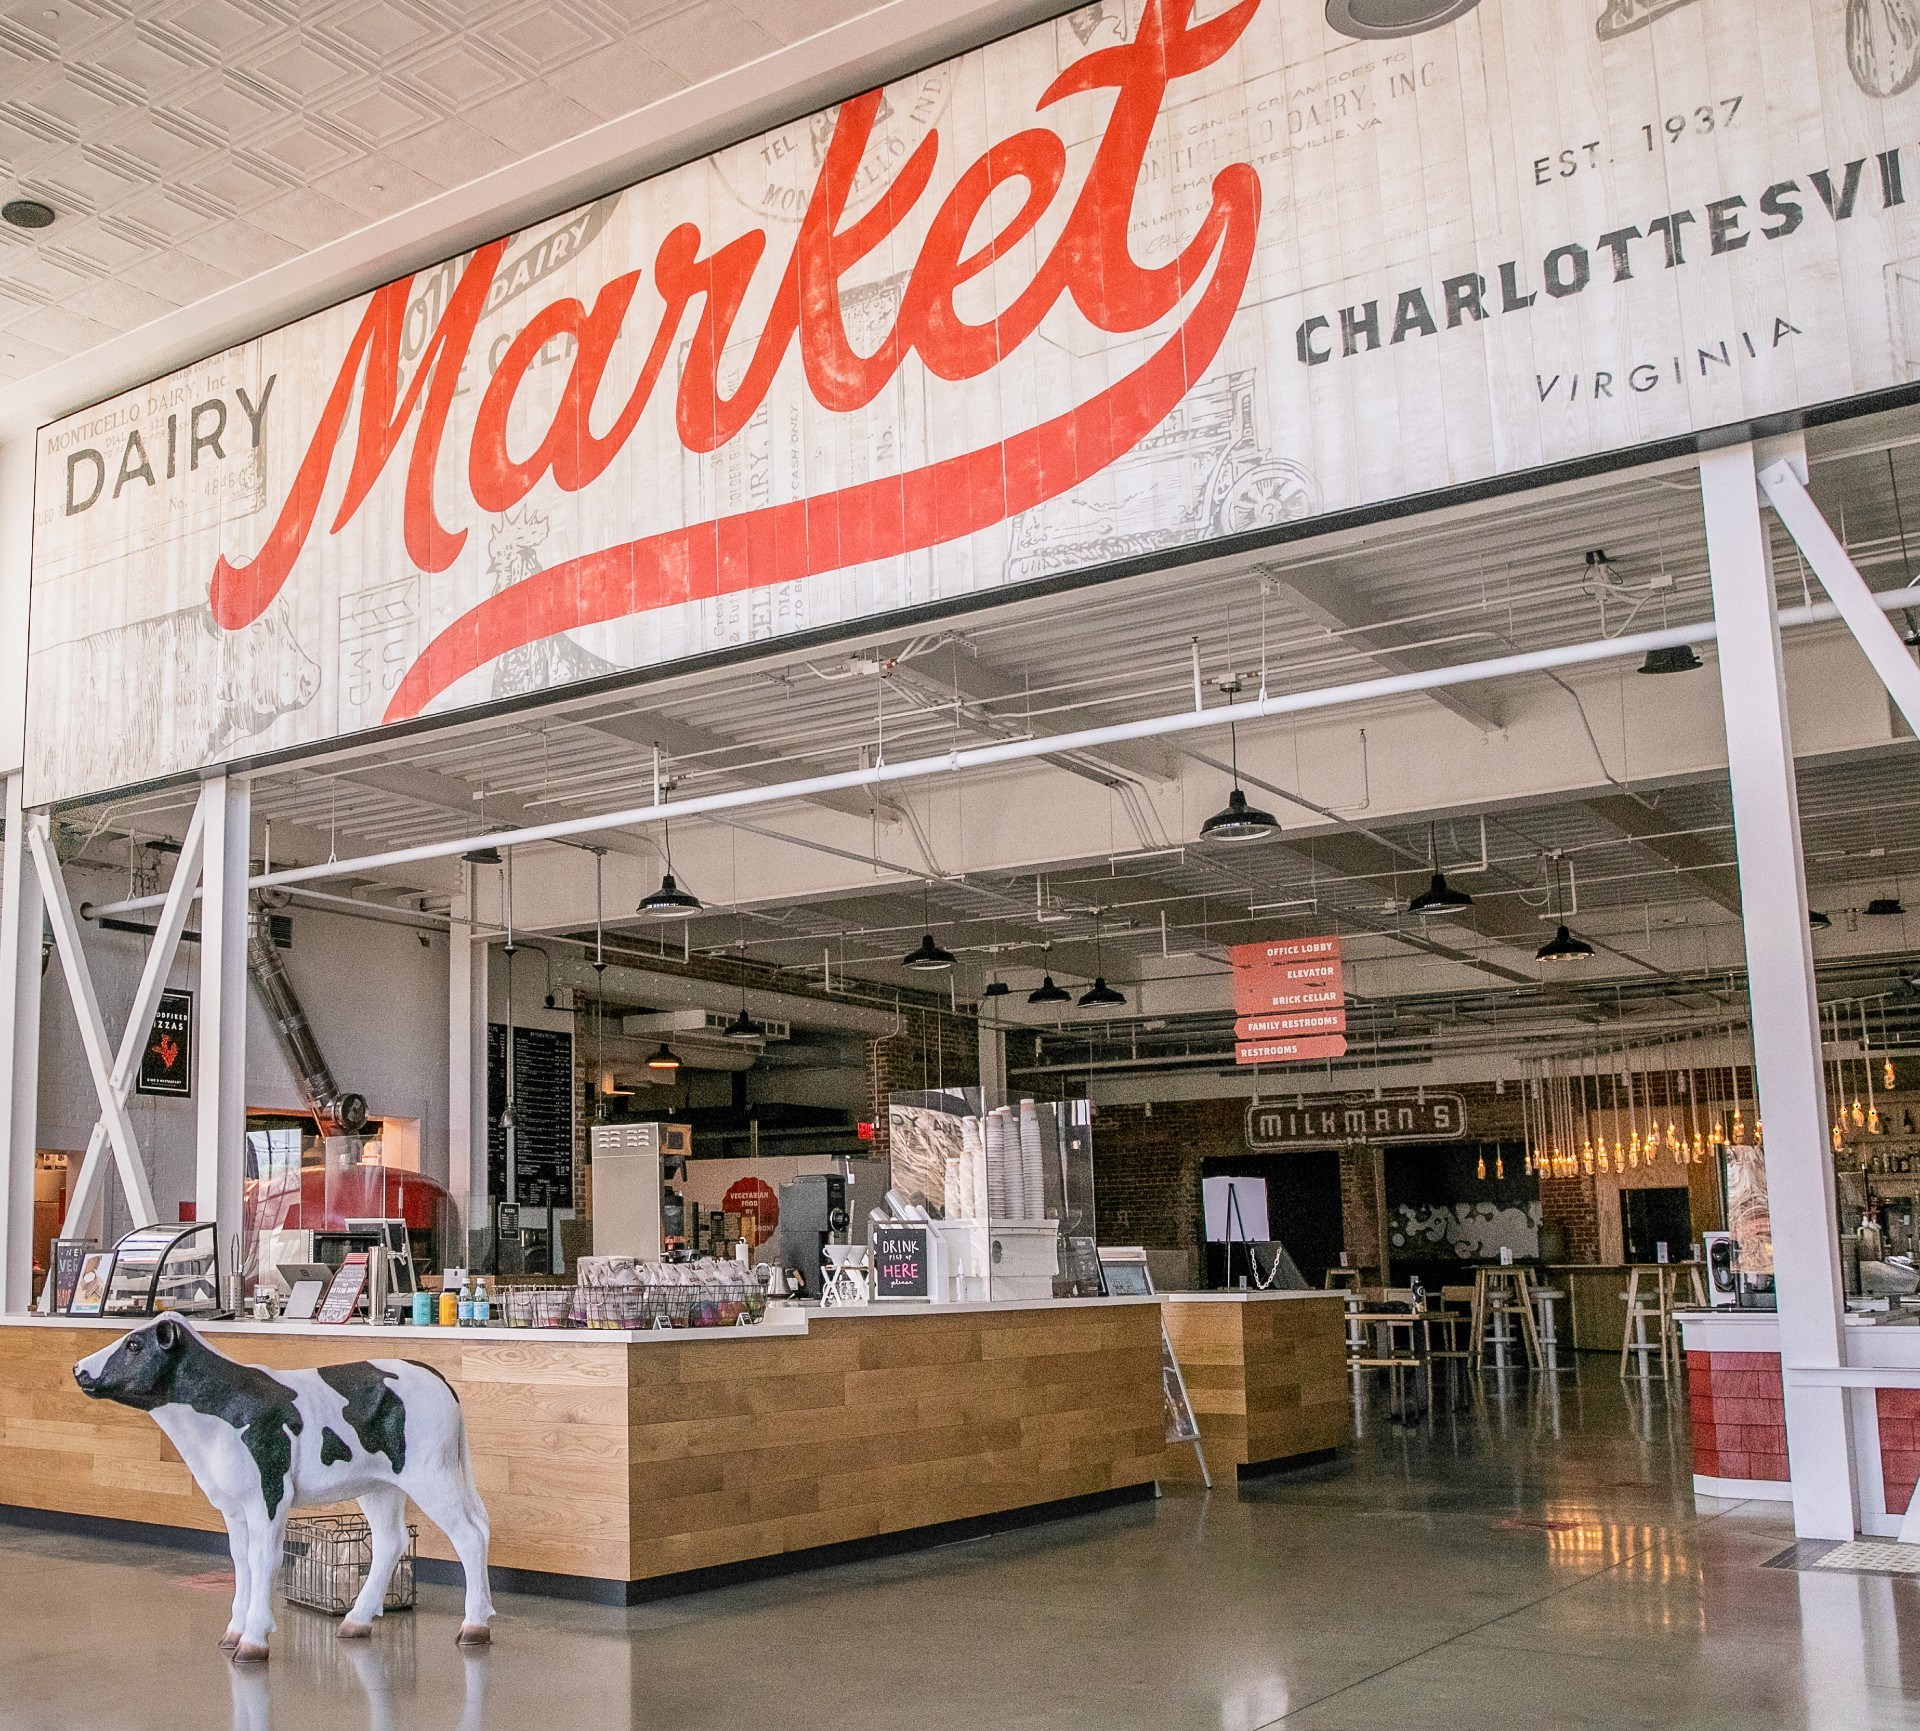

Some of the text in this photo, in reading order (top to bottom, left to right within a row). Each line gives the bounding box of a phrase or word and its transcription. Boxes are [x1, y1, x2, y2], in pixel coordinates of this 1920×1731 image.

[1188, 119, 1223, 136] CAN
[1325, 64, 1376, 85] GOES
[1383, 52, 1406, 67] TO
[1389, 61, 1445, 100] INC.
[1534, 96, 1745, 186] EST. 1937
[486, 214, 591, 309] DAIRY
[1295, 145, 1920, 366] CHARLOTTESVI
[212, 0, 1262, 640] Market
[1536, 317, 1803, 402] VIRGINIA
[47, 404, 140, 456] MONTICELLO
[206, 375, 231, 393] Inc.
[66, 374, 277, 516] DAIRY
[876, 425, 893, 463] No.
[1266, 942, 1333, 957] OFFICE LOBBY
[1287, 967, 1334, 979] ELEVATOR
[1272, 992, 1337, 1006] BRICK CELLAR
[153, 1020, 184, 1031] IZZAS
[156, 1011, 188, 1021] ODFIRED
[1248, 1016, 1338, 1032] FAMILY RESTROOMS
[1241, 1045, 1298, 1058] RESTROOMS
[1259, 1105, 1451, 1138] MILKMAN'S
[730, 1191, 769, 1199] VEGETARIAN
[883, 1240, 920, 1254] DRINK
[883, 1263, 919, 1278] HERE
